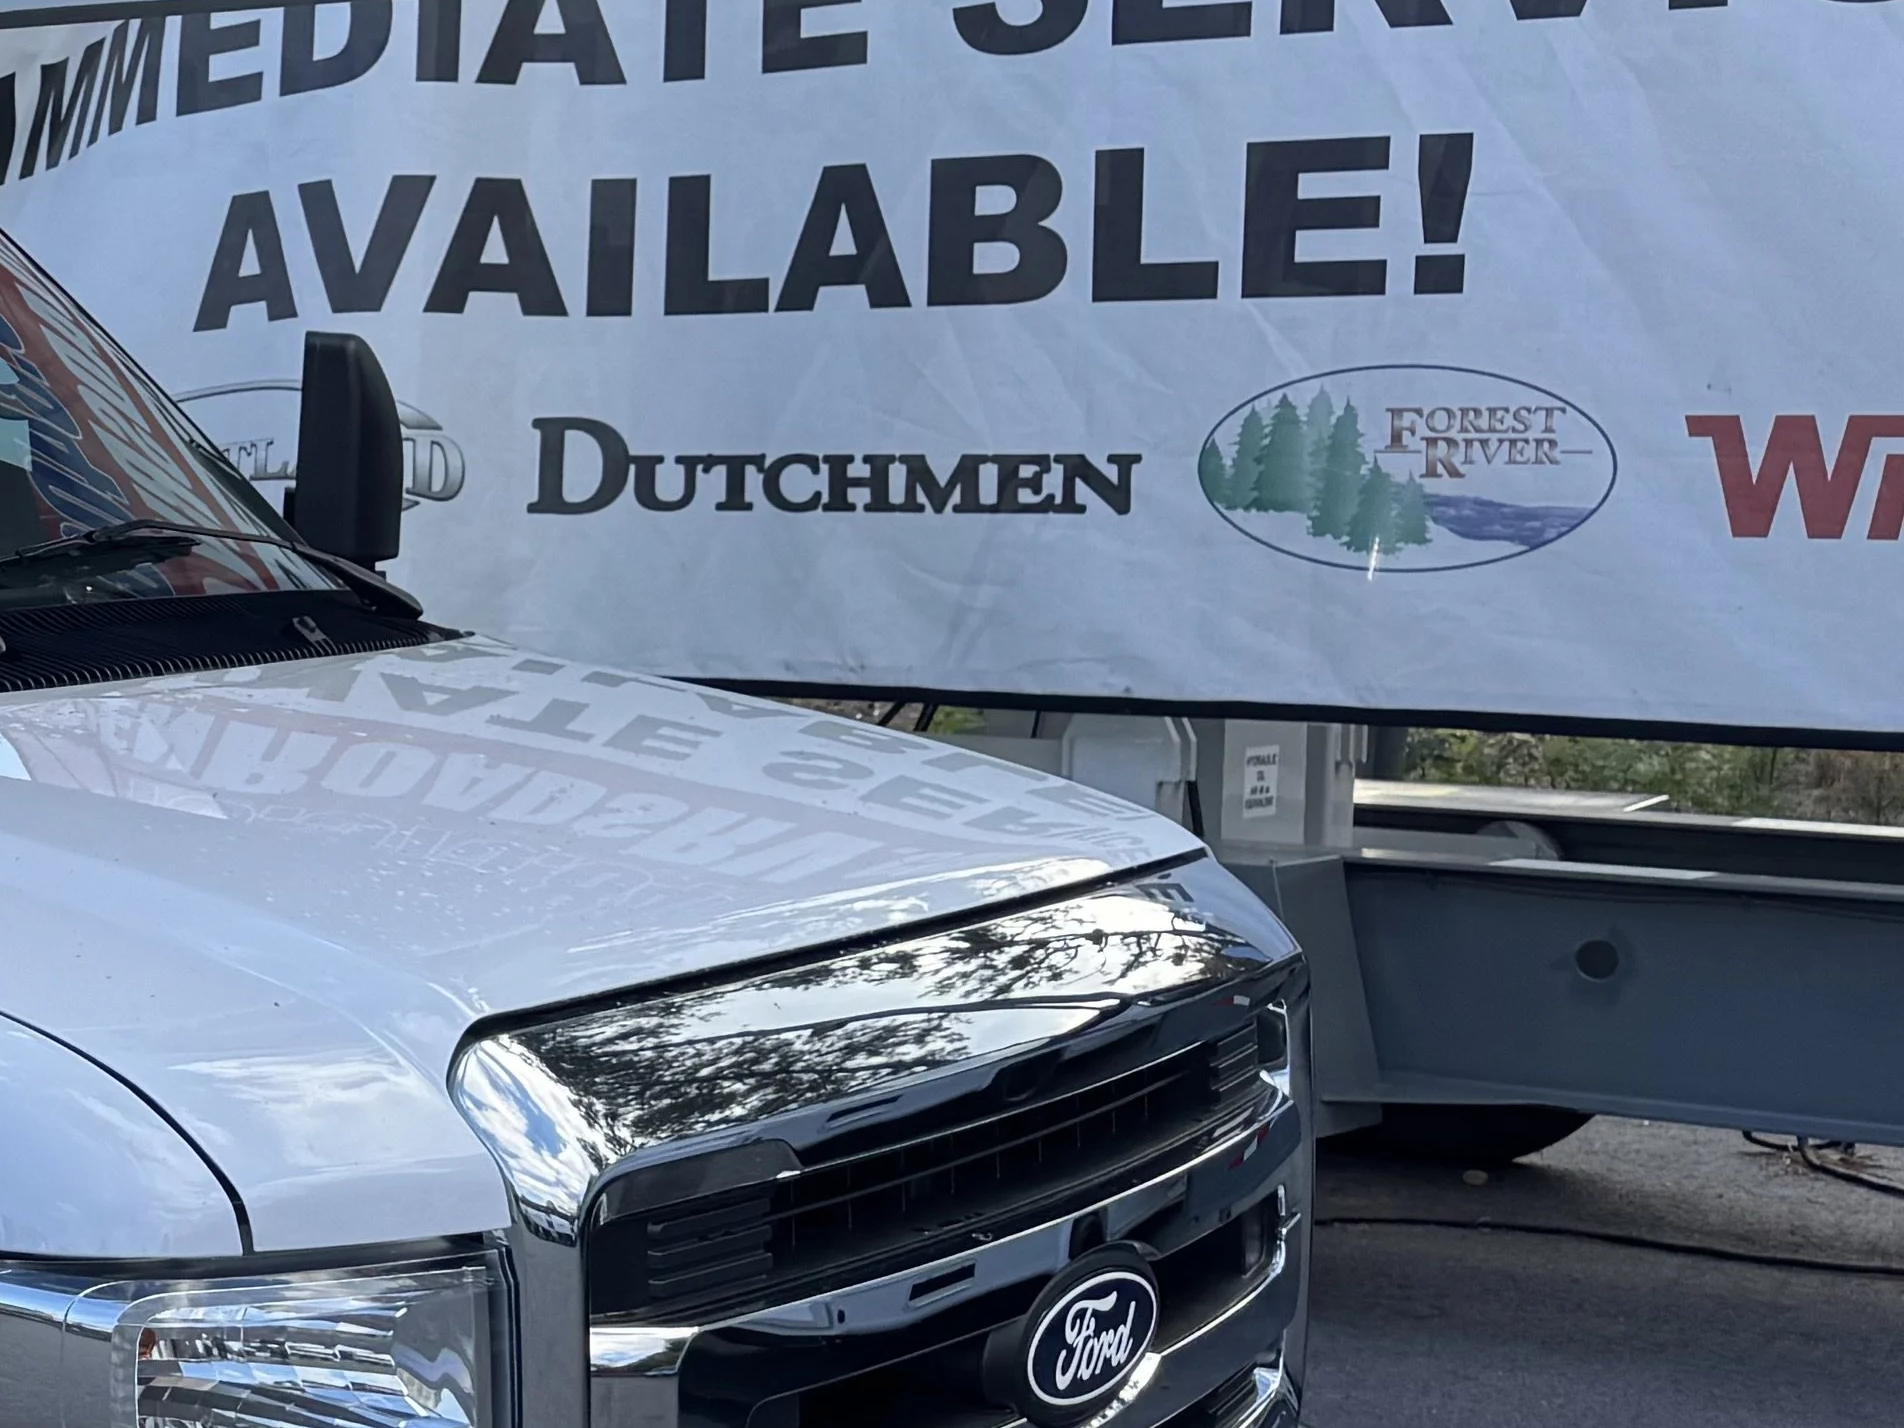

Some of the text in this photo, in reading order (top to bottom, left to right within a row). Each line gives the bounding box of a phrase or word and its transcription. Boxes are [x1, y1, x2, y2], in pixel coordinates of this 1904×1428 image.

[192, 132, 1474, 332] AVAILABLE!
[526, 415, 1142, 515] DUTCHMEN
[1385, 406, 1567, 450] FOREST
[1418, 436, 1561, 479] RIVER
[1056, 1293, 1137, 1391] Ford
